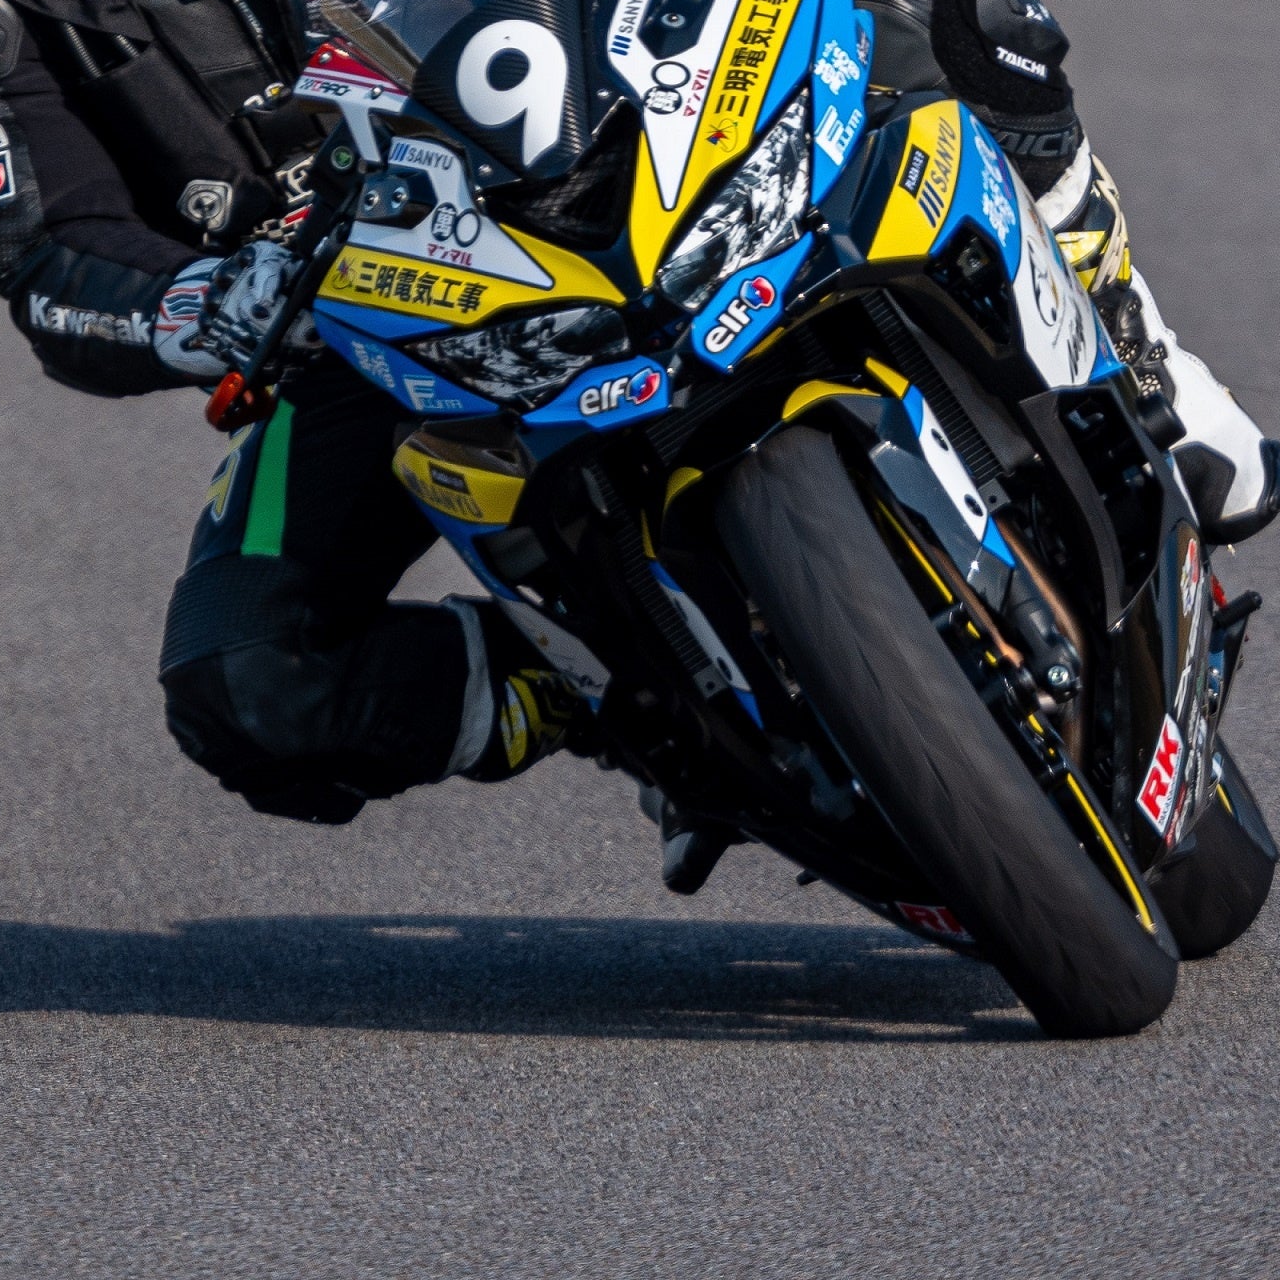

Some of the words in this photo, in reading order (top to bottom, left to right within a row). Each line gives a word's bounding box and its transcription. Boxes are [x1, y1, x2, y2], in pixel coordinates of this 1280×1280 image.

[996, 46, 1048, 79] TAICHI
[457, 19, 568, 167] 9
[407, 147, 452, 171] SANYU
[934, 117, 956, 193] SANYU
[426, 242, 473, 266] マンマル
[354, 260, 489, 314] 三明電気工事
[29, 293, 156, 344] Kawasak
[704, 299, 752, 353] elf
[579, 377, 629, 416] elf
[1141, 720, 1179, 821] RK
